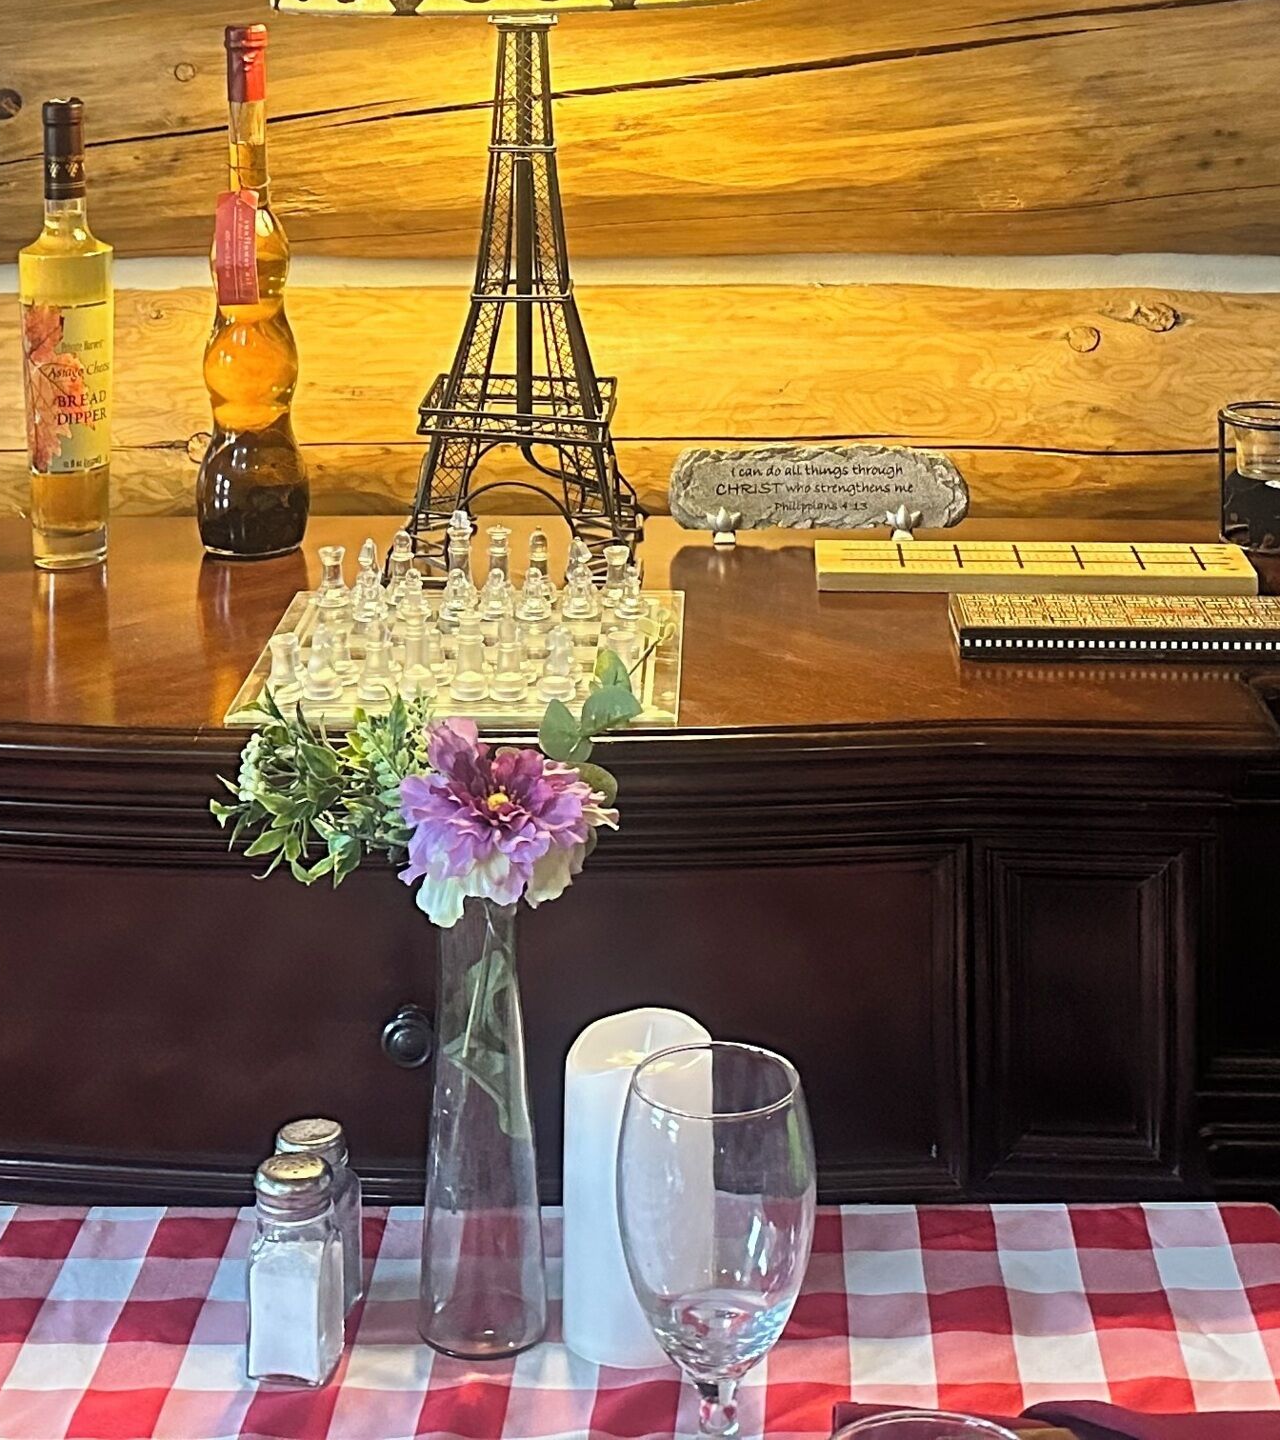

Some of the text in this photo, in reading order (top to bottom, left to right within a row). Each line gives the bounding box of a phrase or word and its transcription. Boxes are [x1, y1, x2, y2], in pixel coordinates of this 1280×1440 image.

[57, 389, 107, 408] BREAD
[56, 407, 108, 427] DIPPER
[739, 467, 763, 477] can
[766, 465, 782, 477] do
[785, 465, 802, 476] all
[805, 464, 849, 480] things
[852, 463, 904, 480] through
[715, 481, 914, 497] CHRIST who strengthens me
[774, 501, 838, 514] Philippians
